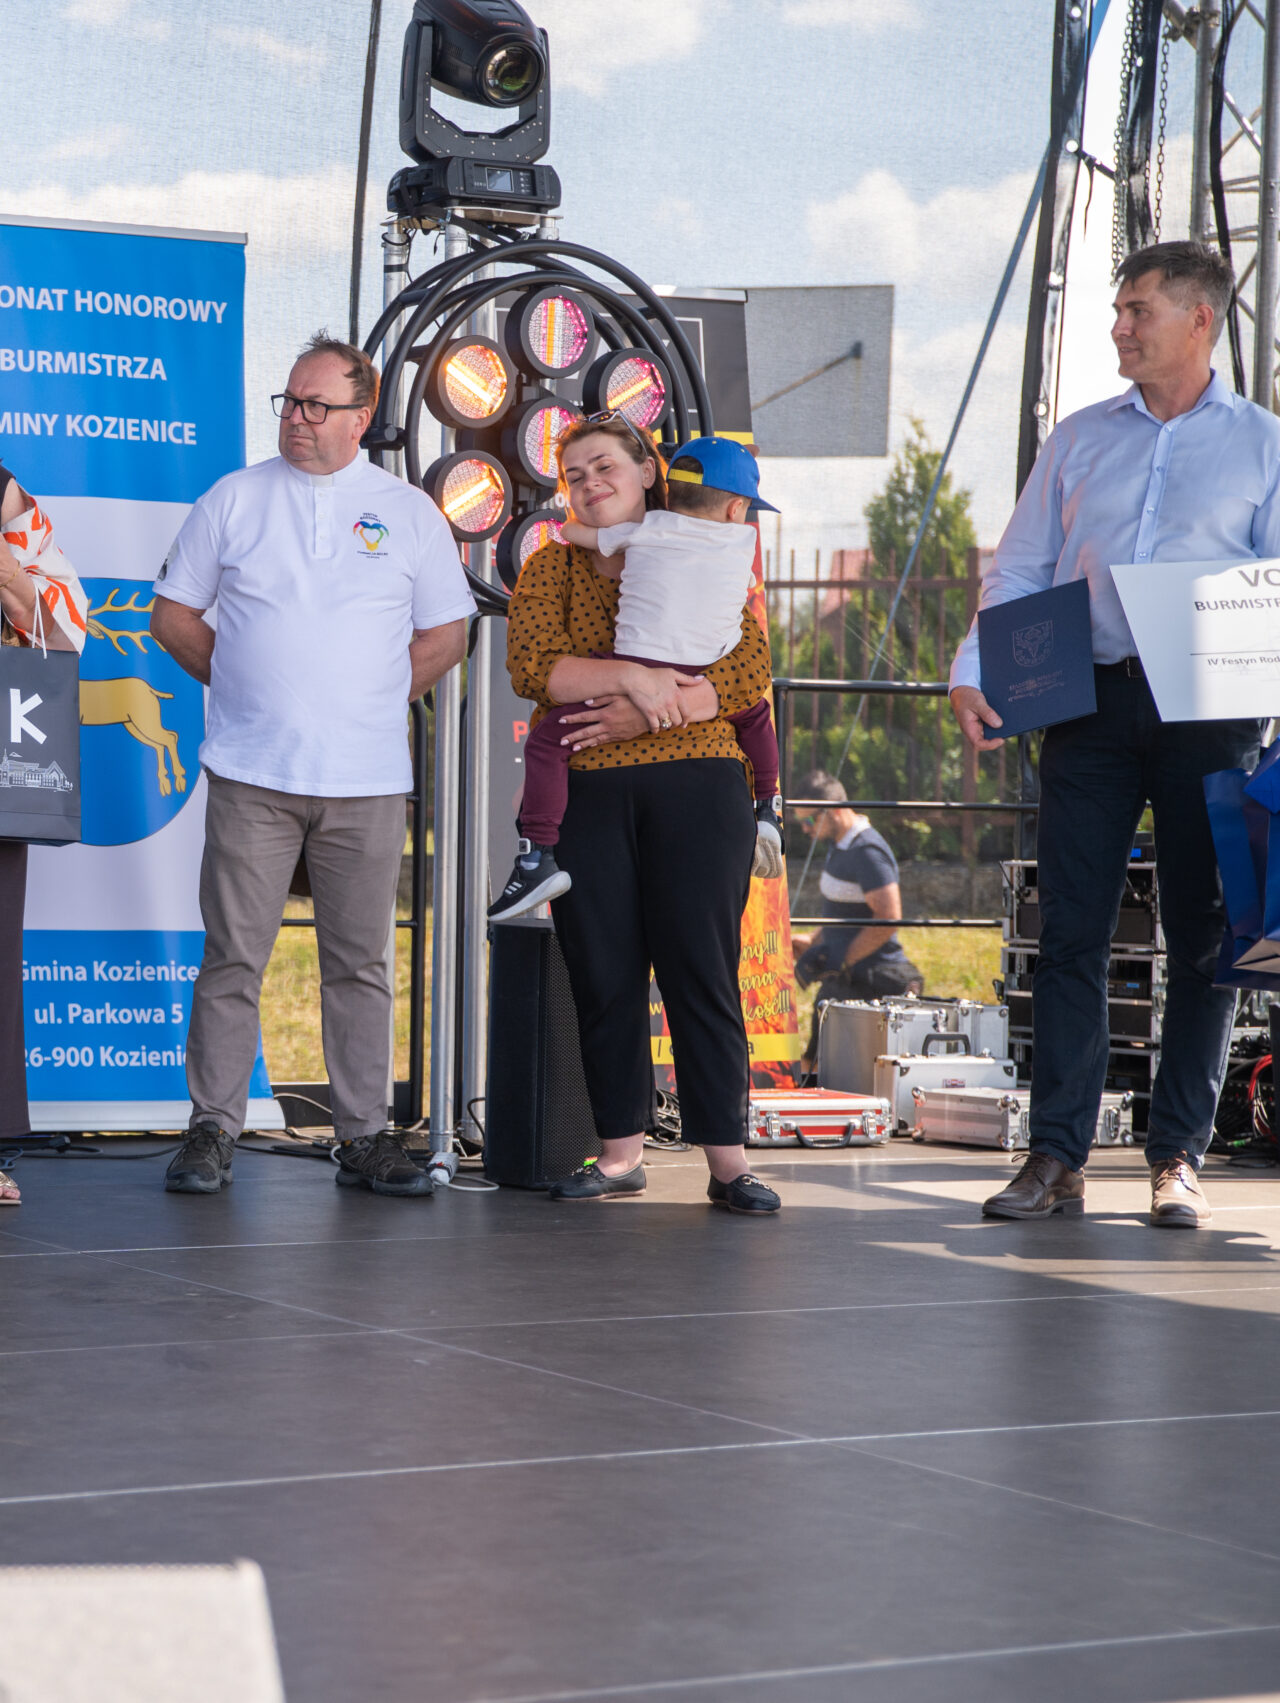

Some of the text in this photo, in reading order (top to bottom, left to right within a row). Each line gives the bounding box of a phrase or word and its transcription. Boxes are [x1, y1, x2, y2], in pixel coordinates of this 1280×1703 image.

[75, 290, 227, 324] HONOROWY
[0, 348, 167, 381] BURMISTRZA
[66, 414, 197, 445] KOZIENICE
[1207, 658, 1218, 666] IV
[1222, 657, 1257, 666] Festyn
[9, 688, 47, 744] K
[94, 960, 200, 981] Kozienice
[34, 1002, 183, 1024] ul. Parkowa 5
[100, 1045, 186, 1067] Kozieni
